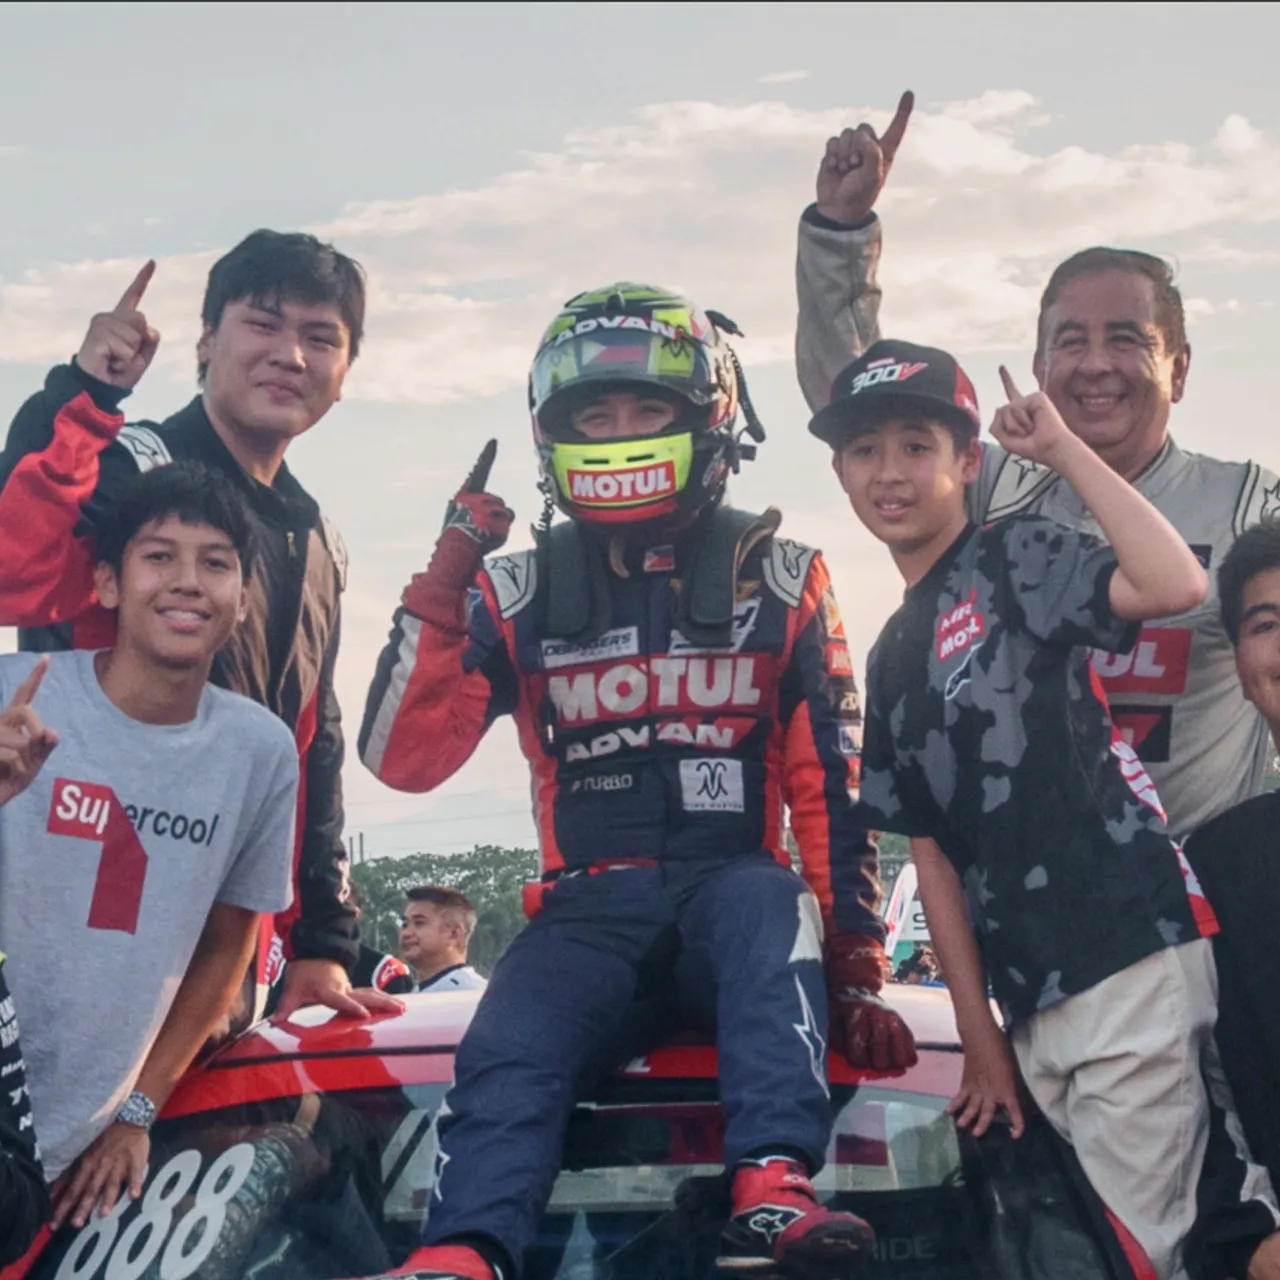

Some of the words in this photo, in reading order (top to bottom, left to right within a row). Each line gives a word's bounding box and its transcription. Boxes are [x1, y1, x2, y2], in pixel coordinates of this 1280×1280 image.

[555, 314, 680, 347] ADVAN
[573, 466, 670, 499] MOTUL
[548, 657, 762, 722] MOTUL
[565, 722, 734, 763] ADVAN
